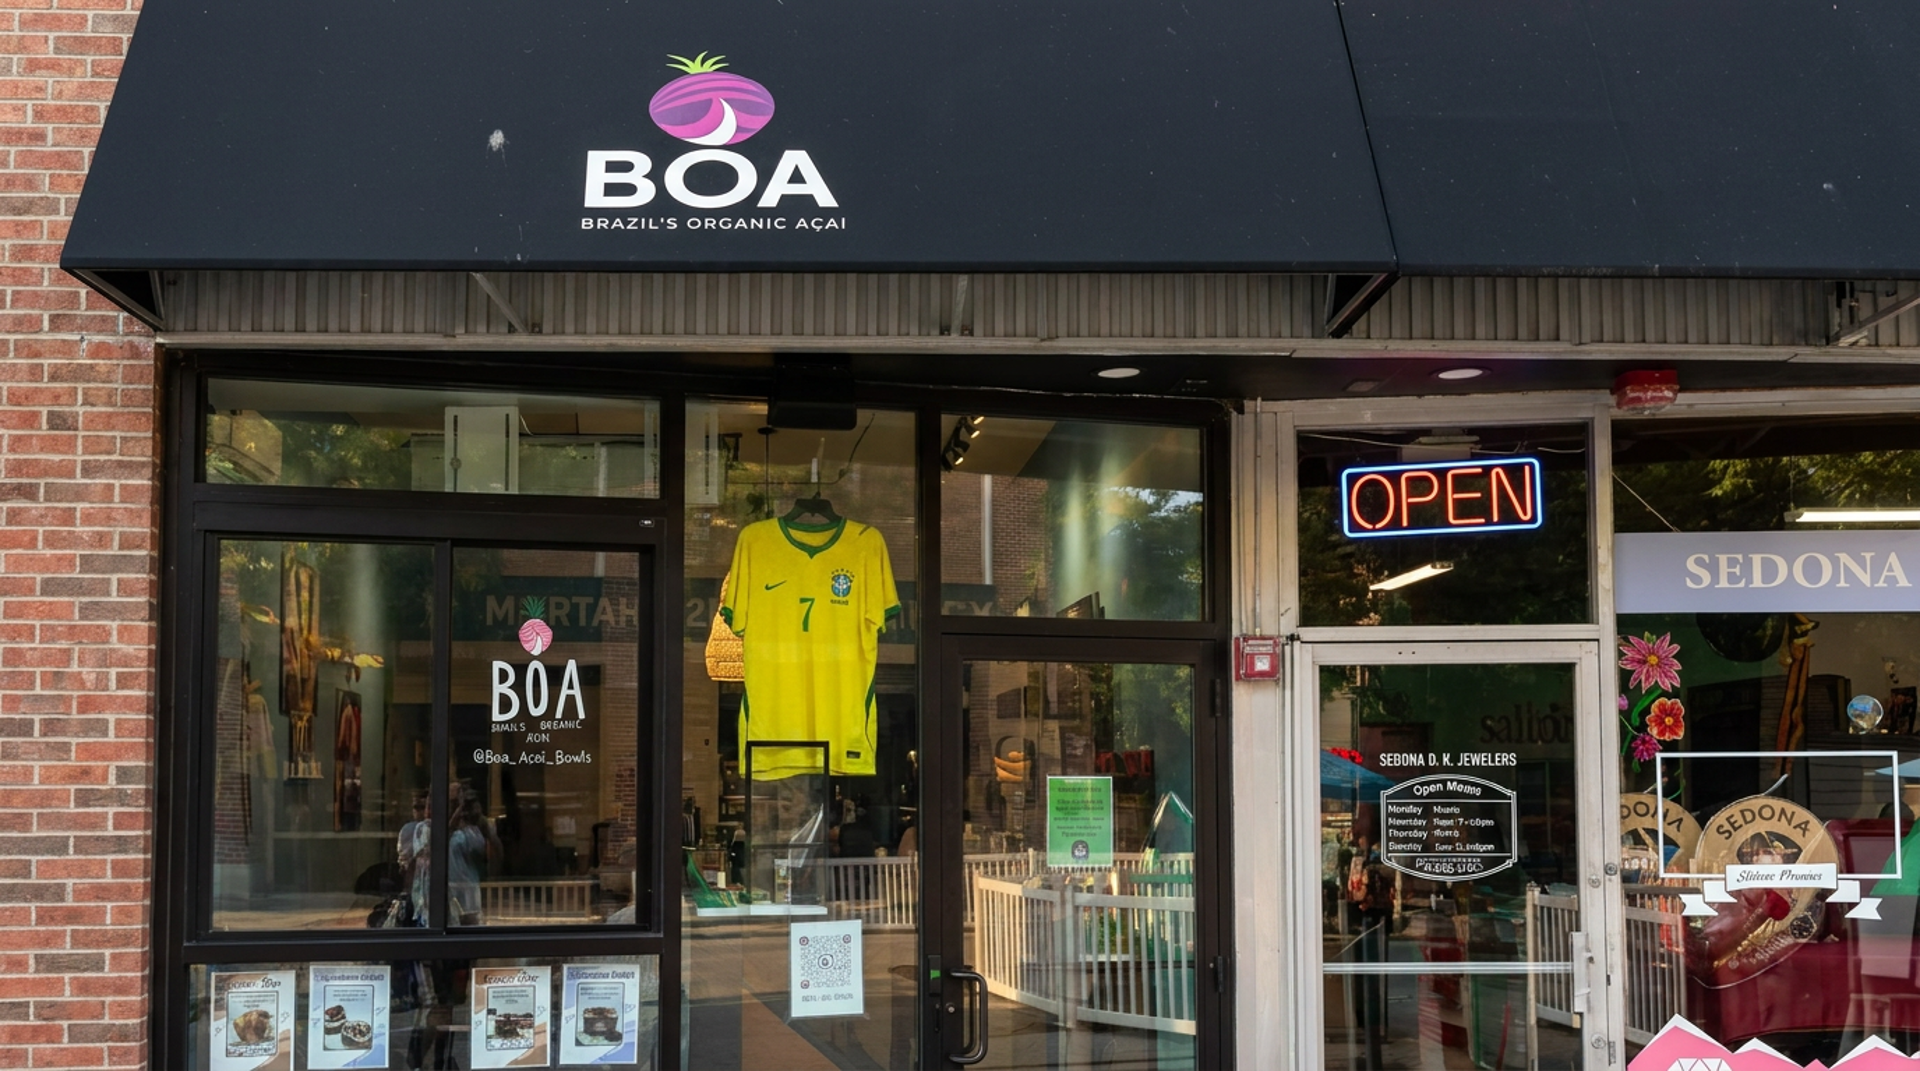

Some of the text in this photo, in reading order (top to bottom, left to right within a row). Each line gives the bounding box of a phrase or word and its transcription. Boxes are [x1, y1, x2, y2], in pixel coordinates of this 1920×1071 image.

[584, 148, 839, 208] BOA
[581, 217, 678, 230] BRAZIL'S
[687, 217, 786, 230] ORGANIC
[1351, 465, 1532, 529] OPEN
[1685, 551, 1912, 589] SEDONA
[486, 595, 638, 628] MRTAH
[800, 598, 815, 632] 7
[492, 659, 585, 722] BOA
[1429, 753, 1440, 767] D.
[1443, 753, 1454, 767] K.
[1457, 753, 1517, 767] JEWELERS
[1413, 783, 1444, 796] Open
[1716, 804, 1811, 841] SEDONA
